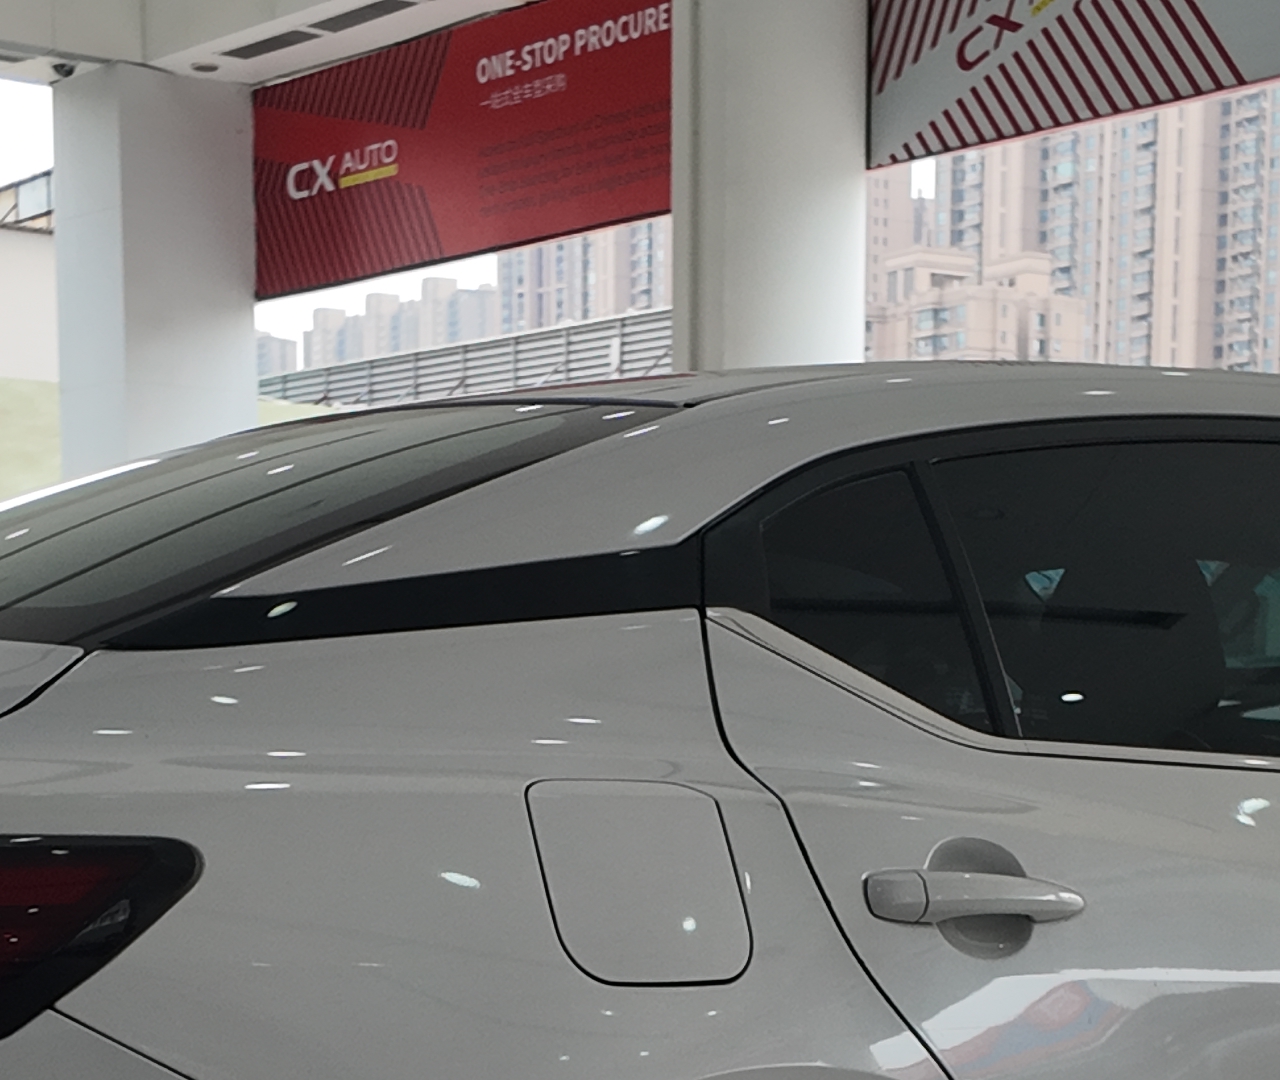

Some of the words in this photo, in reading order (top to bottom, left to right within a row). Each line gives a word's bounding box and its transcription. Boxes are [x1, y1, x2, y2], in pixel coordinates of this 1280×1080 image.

[476, 33, 571, 84] ONE-STOP
[286, 155, 337, 200] CX
[339, 139, 399, 175] AUTO
